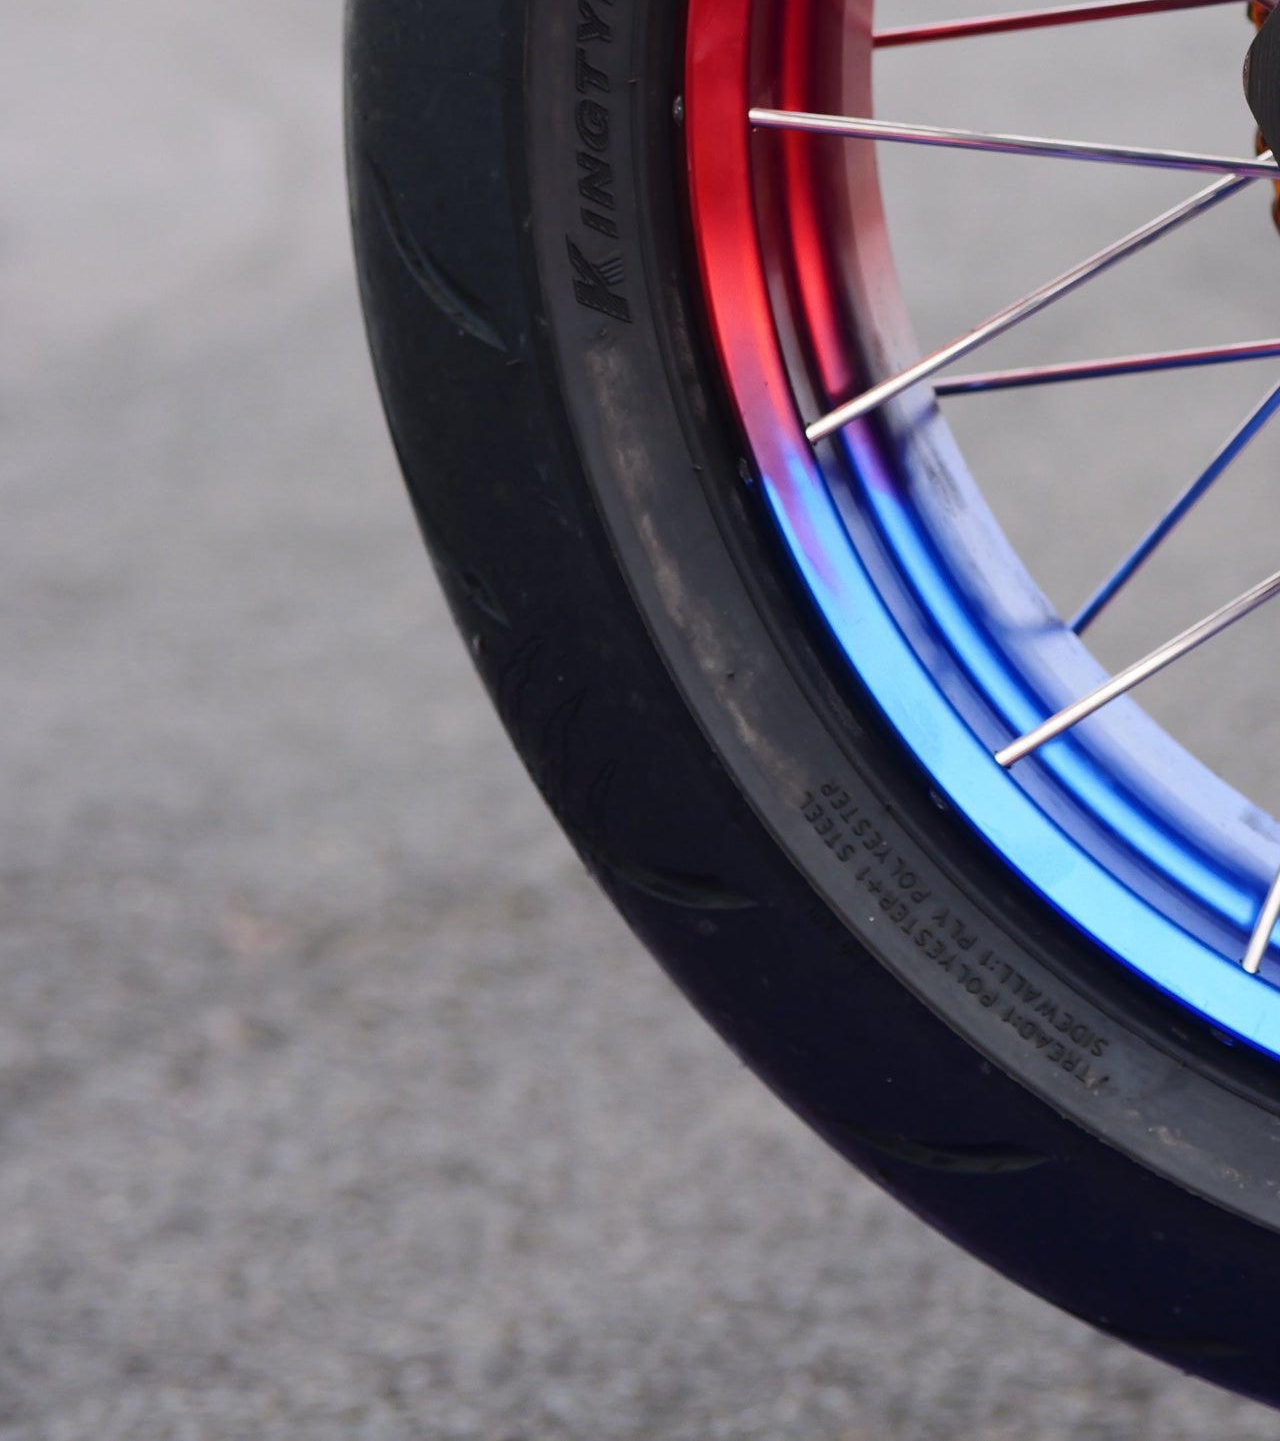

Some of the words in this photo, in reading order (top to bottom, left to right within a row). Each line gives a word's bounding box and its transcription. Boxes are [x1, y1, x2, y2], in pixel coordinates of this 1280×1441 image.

[800, 790, 855, 862] STEEL
[820, 782, 932, 904] POLYESTER
[931, 908, 978, 951] PLY
